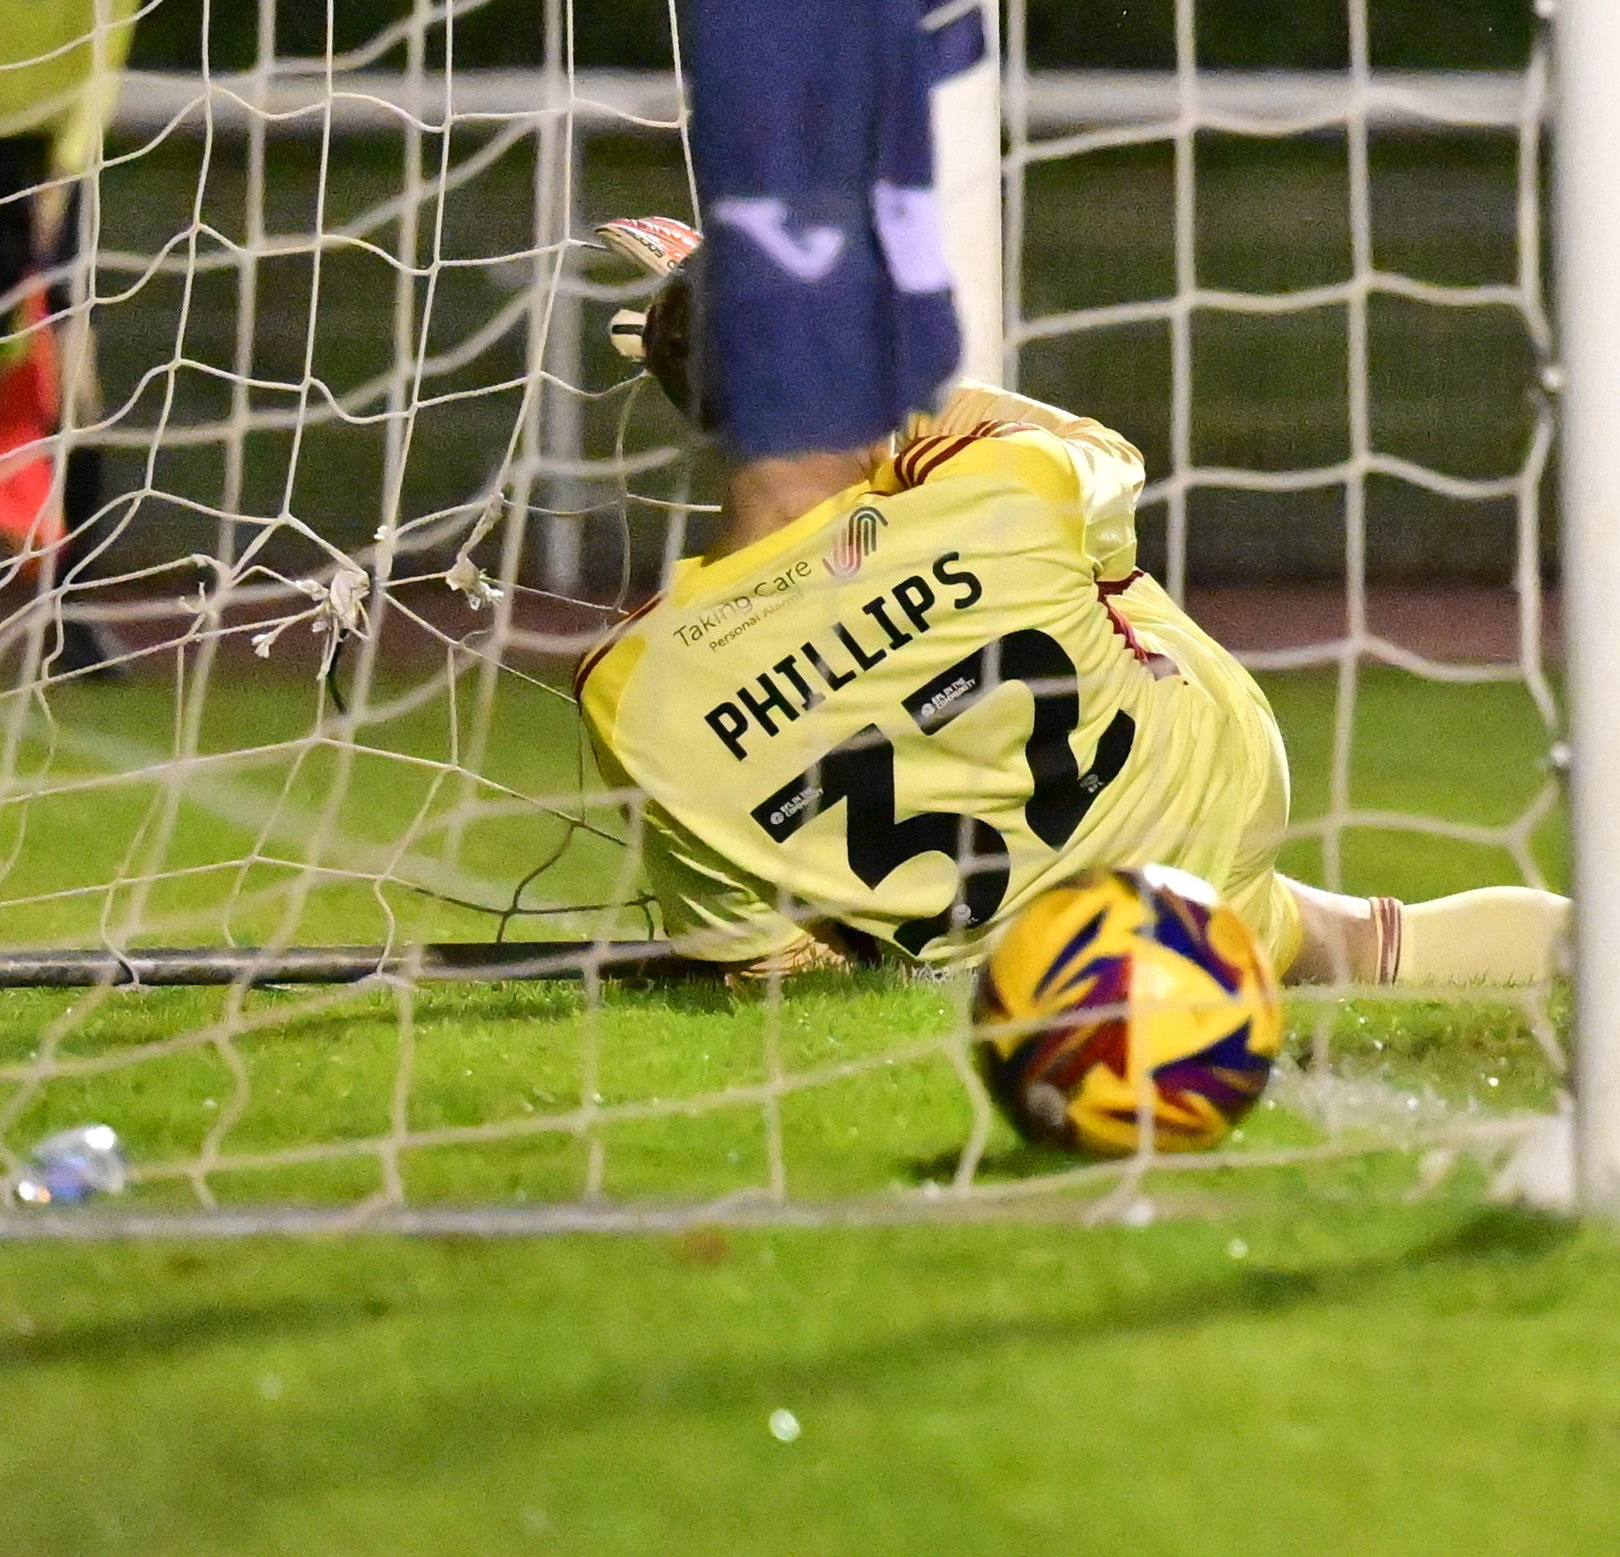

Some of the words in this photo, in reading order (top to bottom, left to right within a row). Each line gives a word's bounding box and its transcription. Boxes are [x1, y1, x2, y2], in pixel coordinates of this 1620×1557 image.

[672, 595, 754, 648] Taking
[753, 559, 813, 598] Care
[703, 550, 983, 762] PHILLIPS
[708, 613, 762, 653] Personal
[749, 628, 1137, 957] 32
